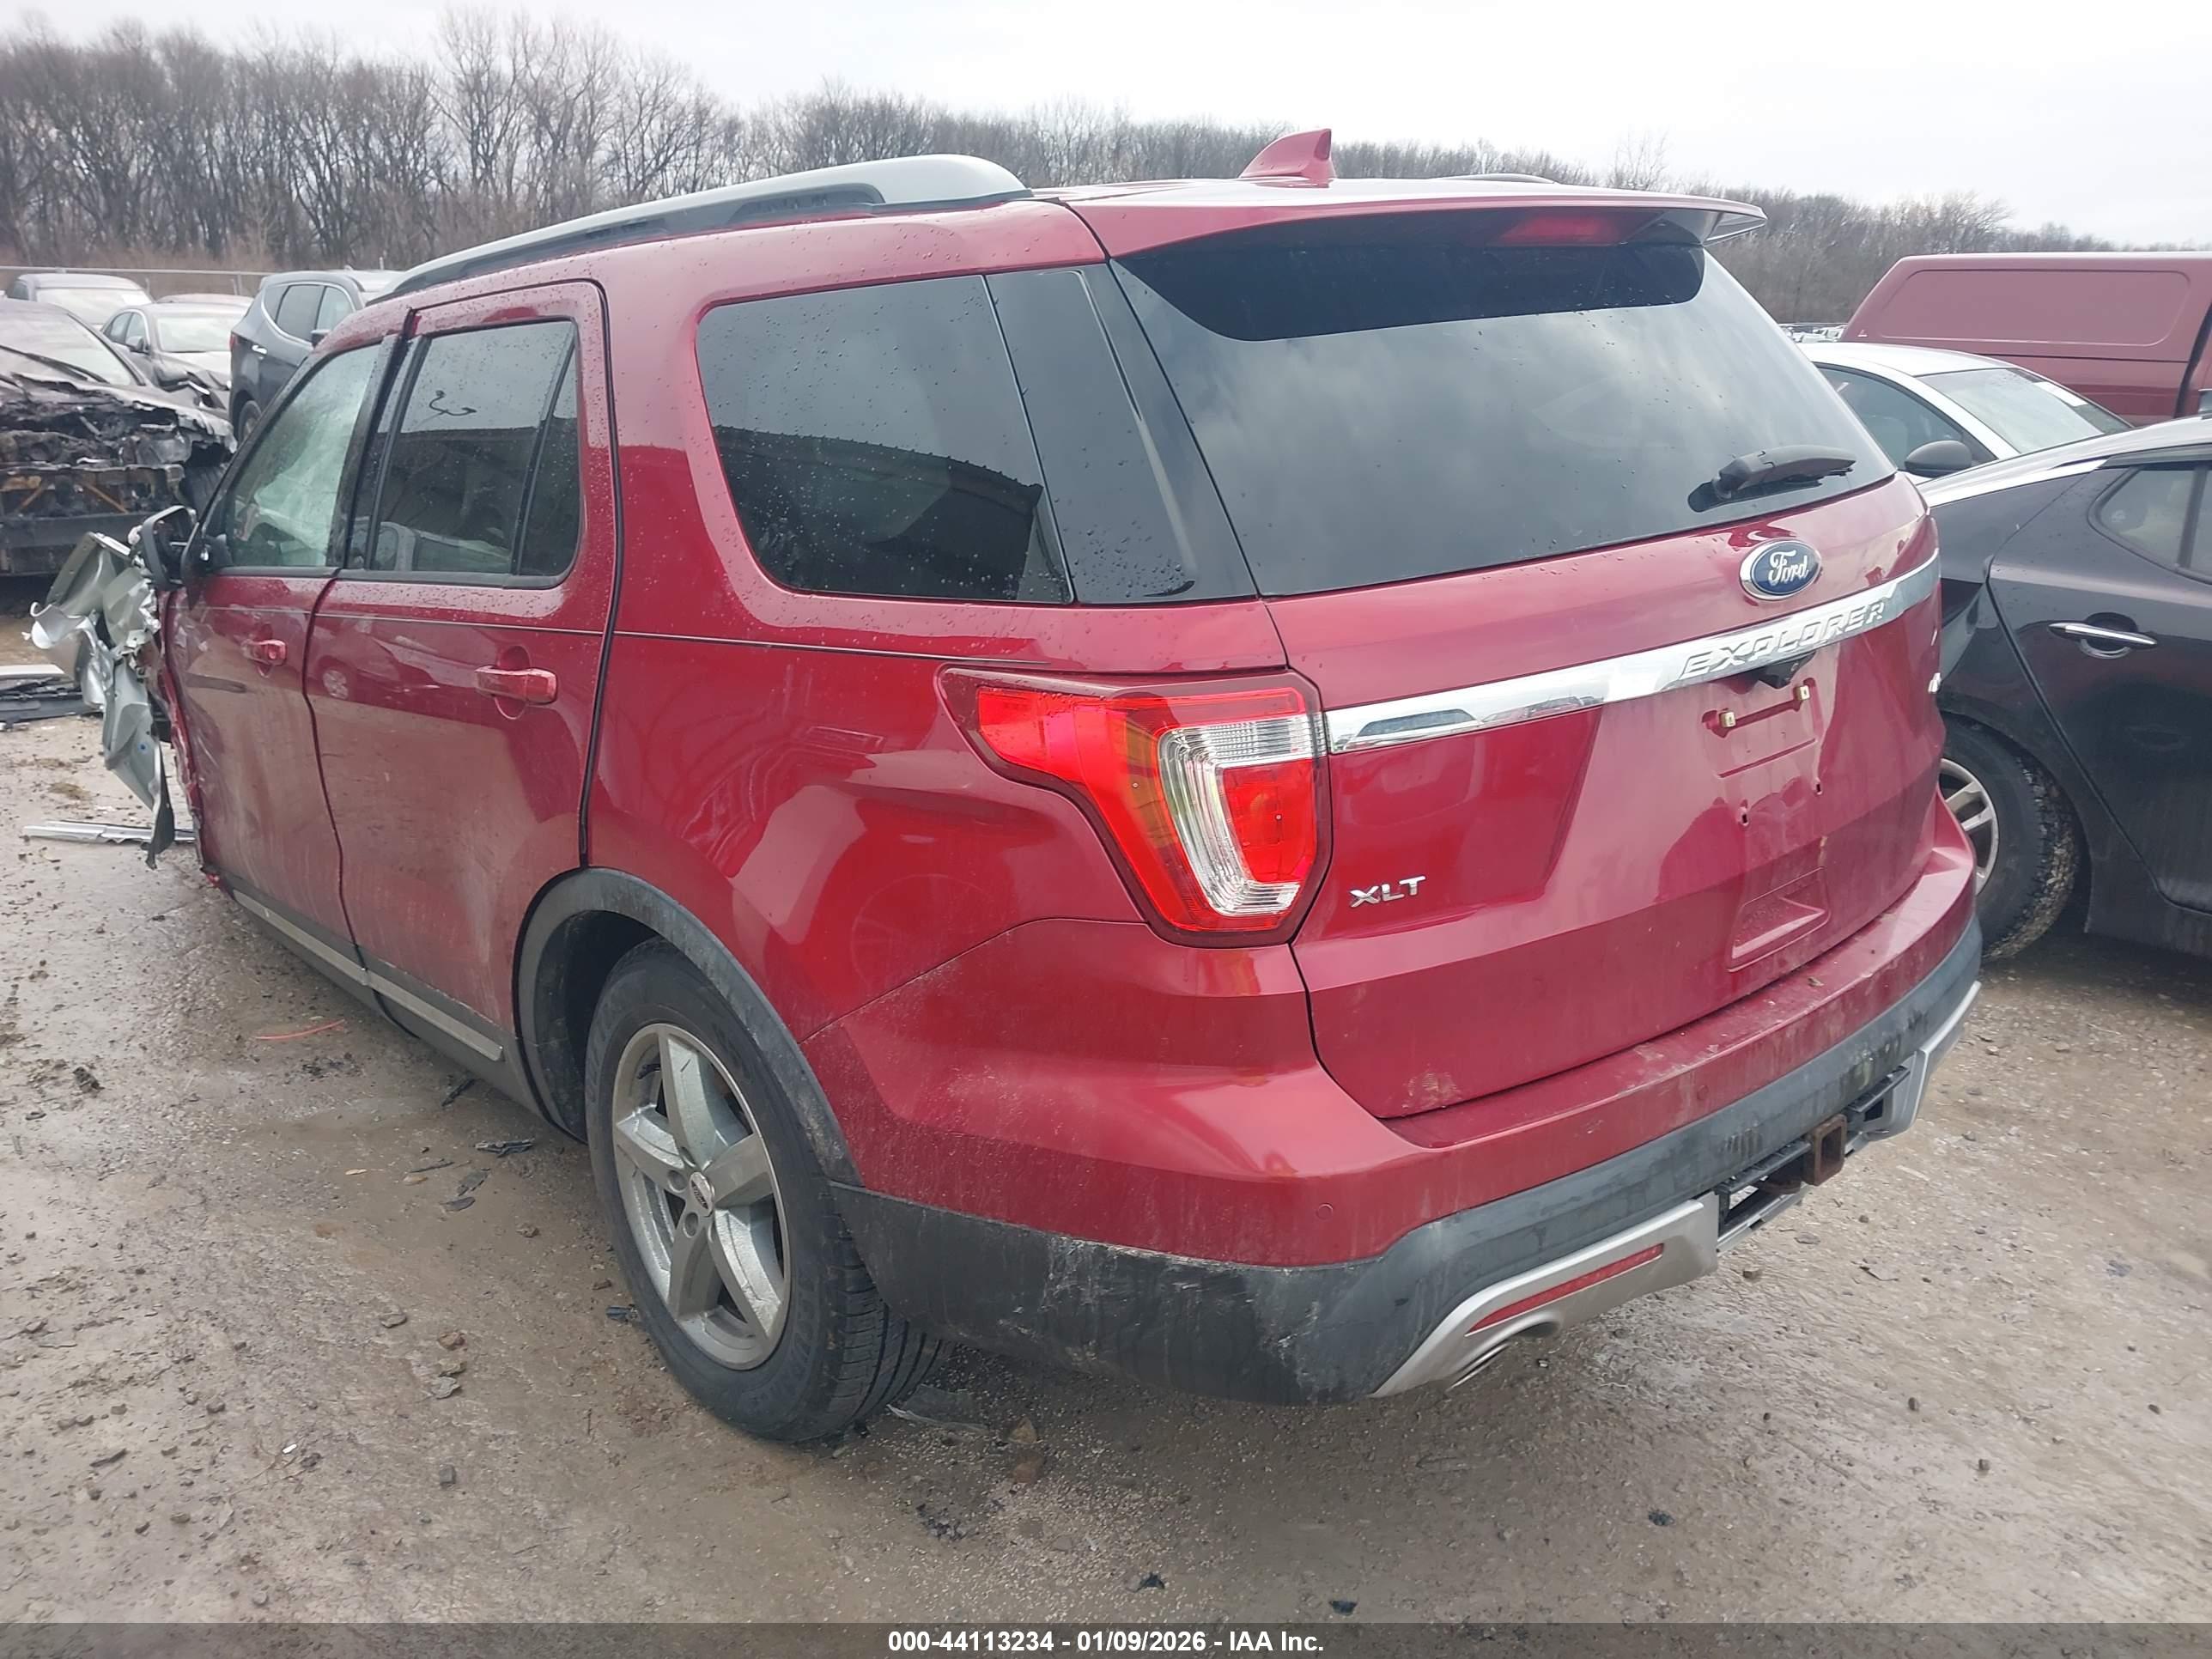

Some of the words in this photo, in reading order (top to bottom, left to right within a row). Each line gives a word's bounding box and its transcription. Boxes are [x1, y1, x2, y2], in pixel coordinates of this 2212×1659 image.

[1767, 550, 1810, 586] Ford
[1679, 600, 1887, 680] EXPLORER
[1350, 876, 1426, 908] XLT
